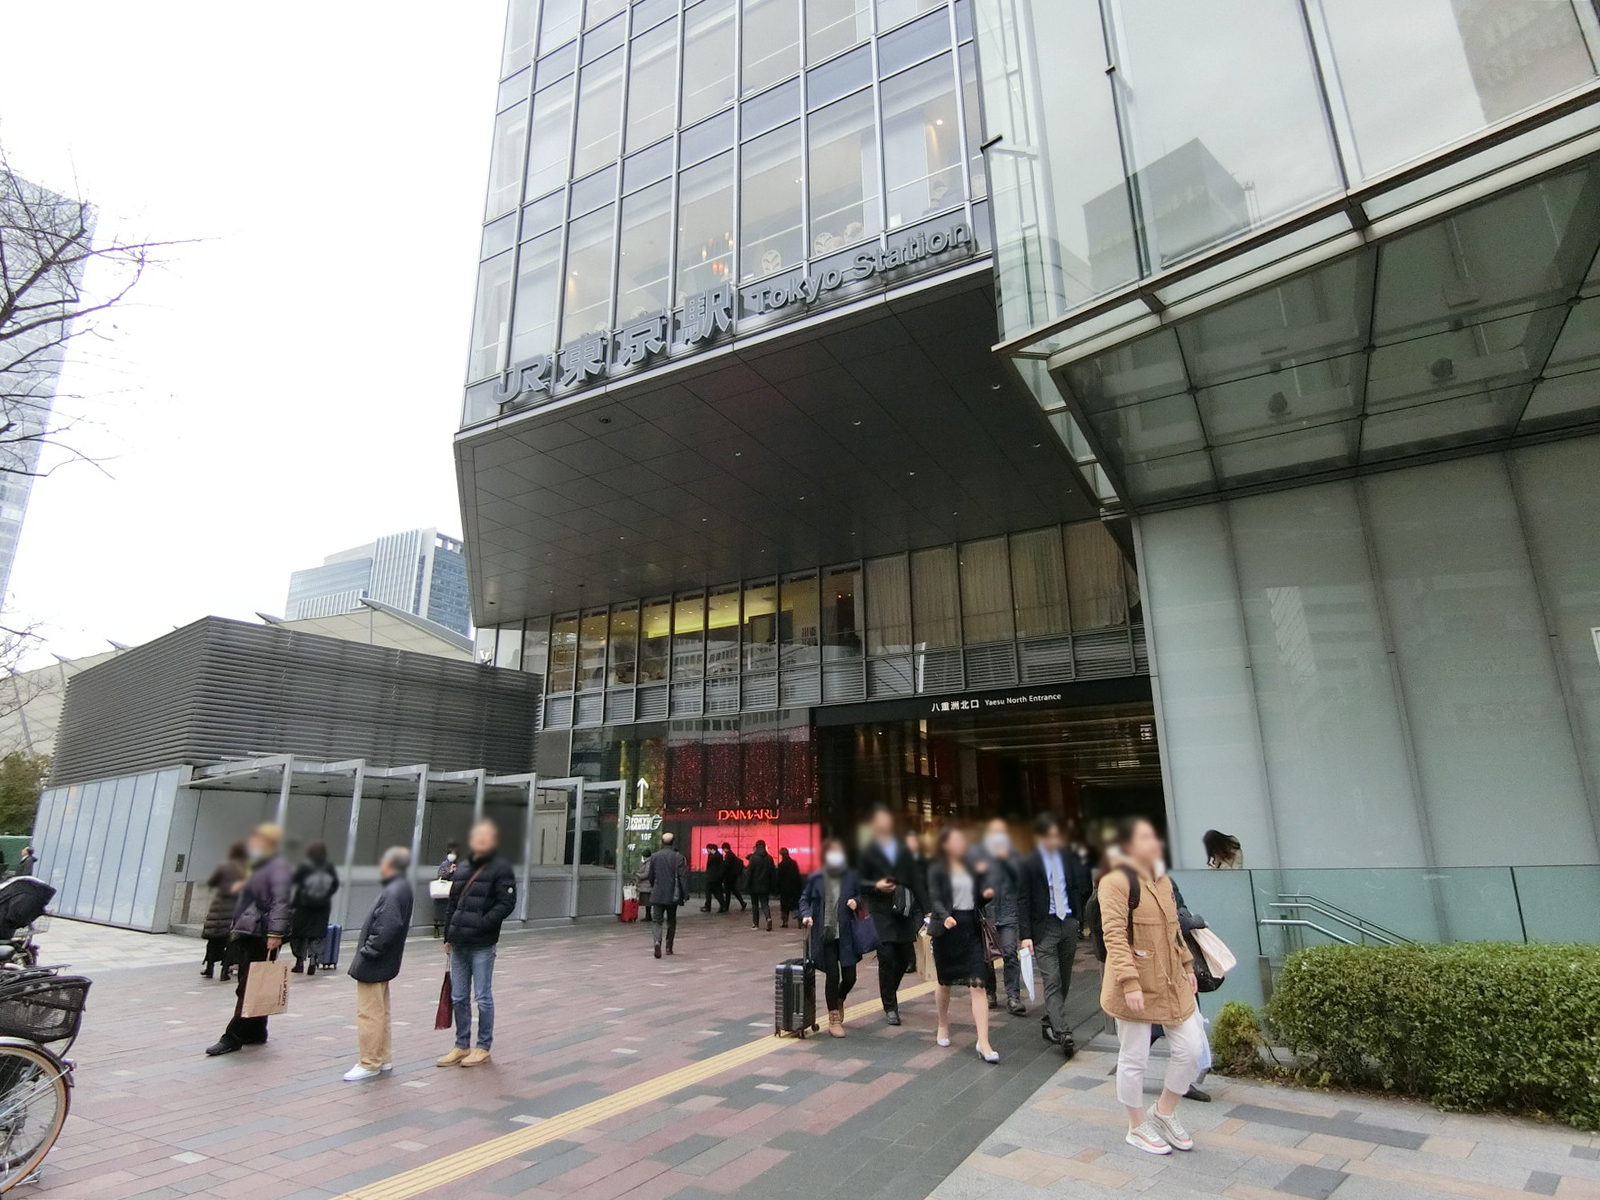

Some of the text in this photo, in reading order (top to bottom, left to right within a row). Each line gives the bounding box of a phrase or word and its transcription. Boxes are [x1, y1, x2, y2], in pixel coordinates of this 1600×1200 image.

[493, 220, 975, 404] JR東京駅 Tokyo Station
[931, 692, 1062, 712] 八重洲北口 Yaesu North Entrance
[718, 808, 780, 821] DAIMARU
